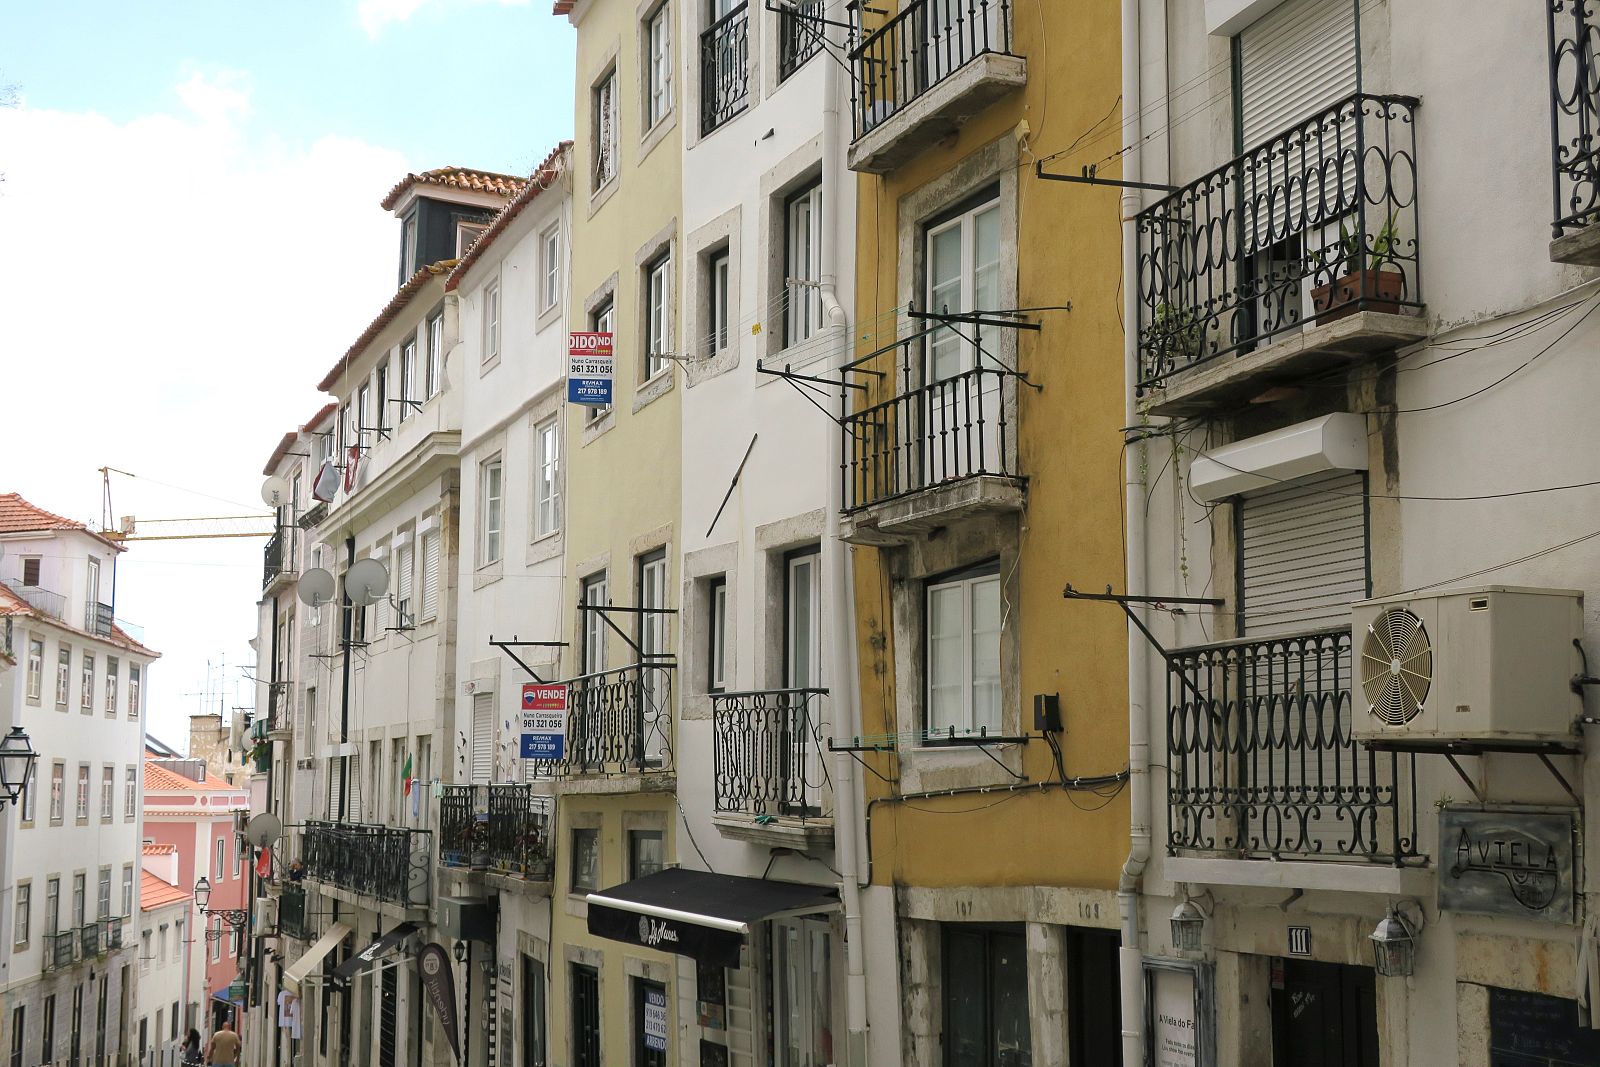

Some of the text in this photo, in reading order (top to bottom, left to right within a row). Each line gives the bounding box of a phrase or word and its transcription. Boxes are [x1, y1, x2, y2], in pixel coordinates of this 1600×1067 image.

[571, 365, 584, 373] 961
[585, 365, 598, 373] 321
[537, 689, 565, 699] VENDE
[523, 719, 562, 728] 961 321 056
[956, 900, 973, 917] 107
[1291, 928, 1308, 953] 111
[1177, 1018, 1186, 1028] do
